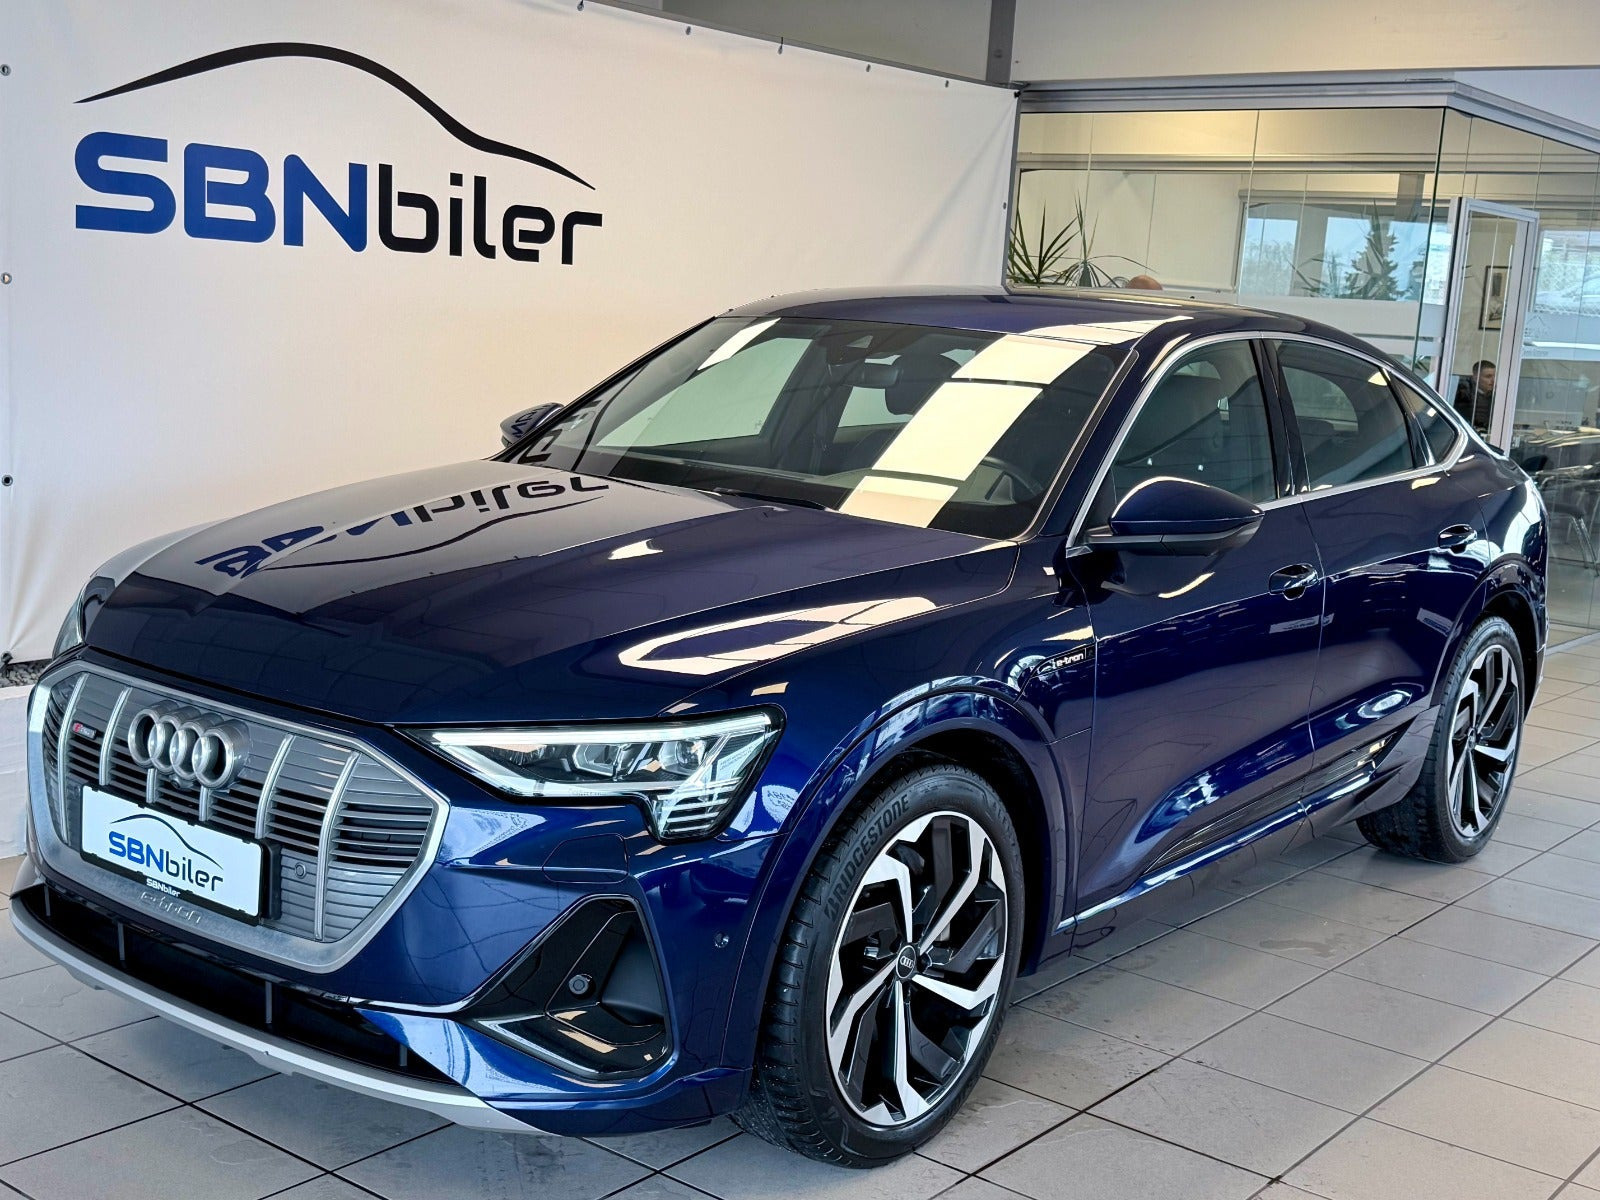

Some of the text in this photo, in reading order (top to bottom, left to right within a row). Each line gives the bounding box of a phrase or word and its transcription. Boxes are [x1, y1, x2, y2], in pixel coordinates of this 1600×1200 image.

[75, 131, 603, 266] SBNbiler
[1056, 653, 1084, 667] e-tron
[108, 830, 224, 892] SBNbiler
[146, 877, 181, 898] SBNbiler
[824, 793, 910, 923] BRIDGESTONE
